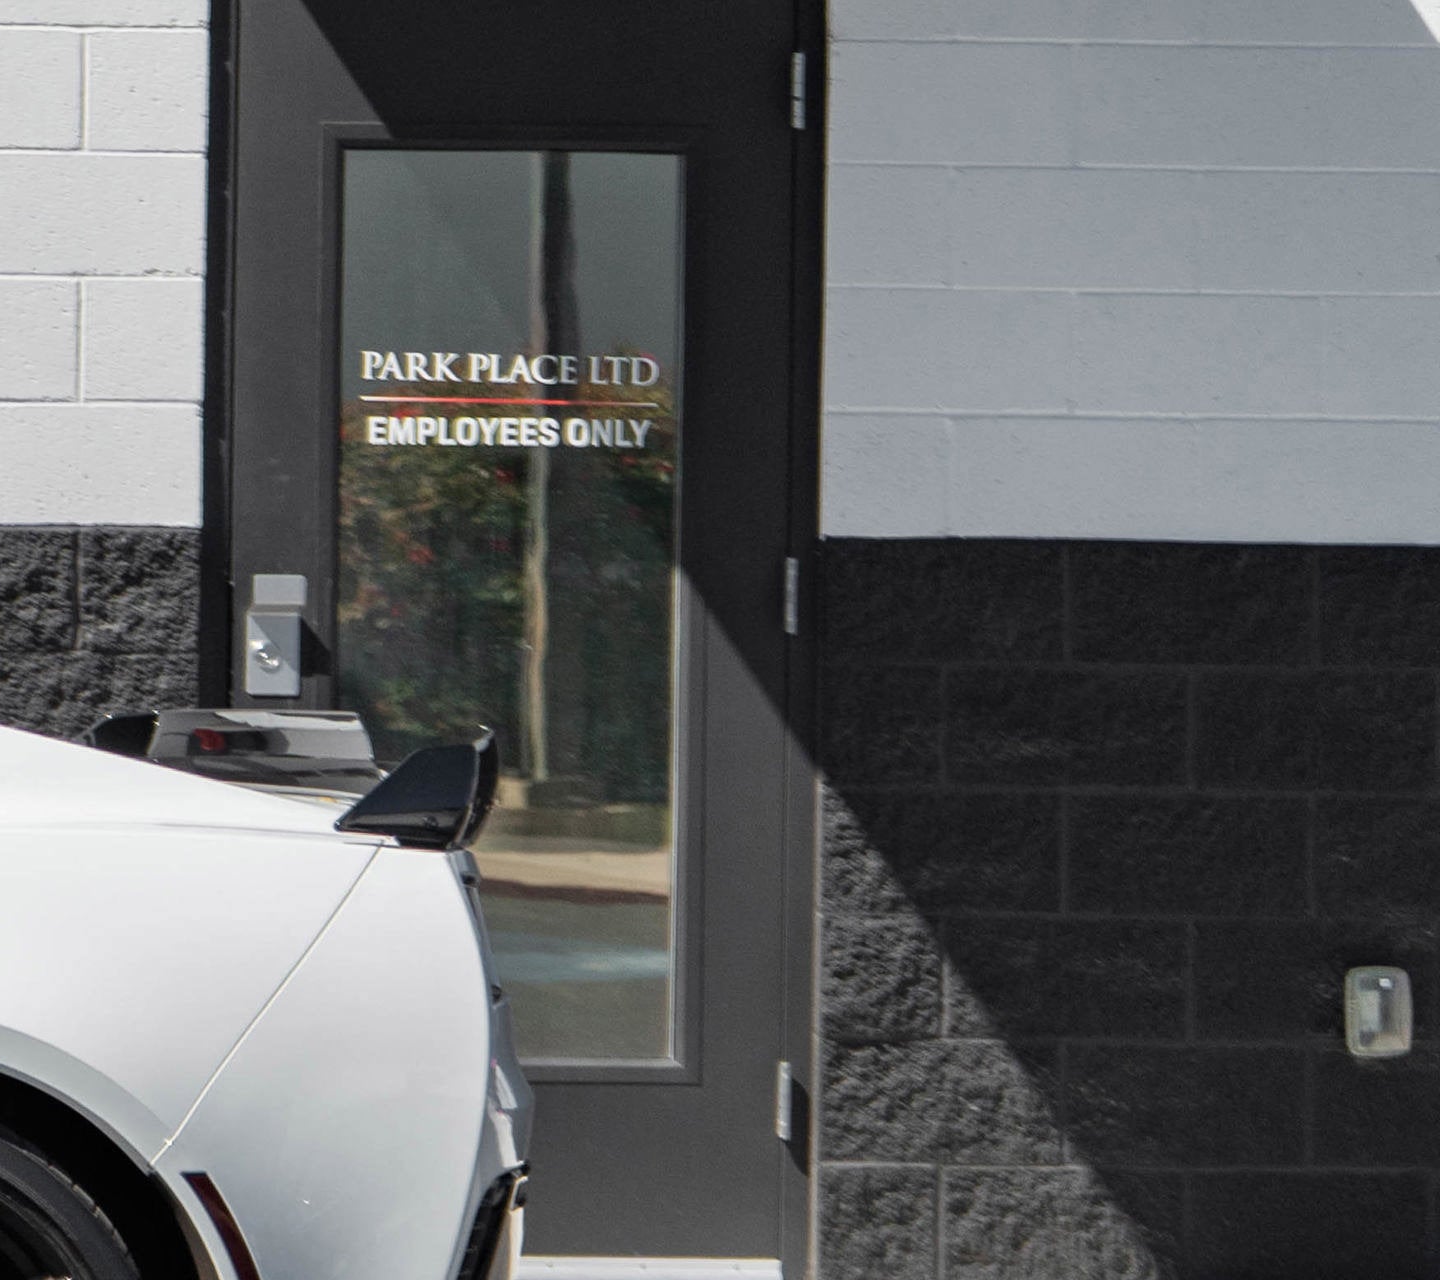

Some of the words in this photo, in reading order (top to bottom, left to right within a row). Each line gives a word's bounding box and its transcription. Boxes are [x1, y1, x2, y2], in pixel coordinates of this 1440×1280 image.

[360, 350, 463, 383] PARK
[467, 352, 578, 385] PLACE
[589, 356, 660, 387] LTD
[366, 416, 561, 447] EMPLOYEES
[567, 419, 653, 449] ONLY
